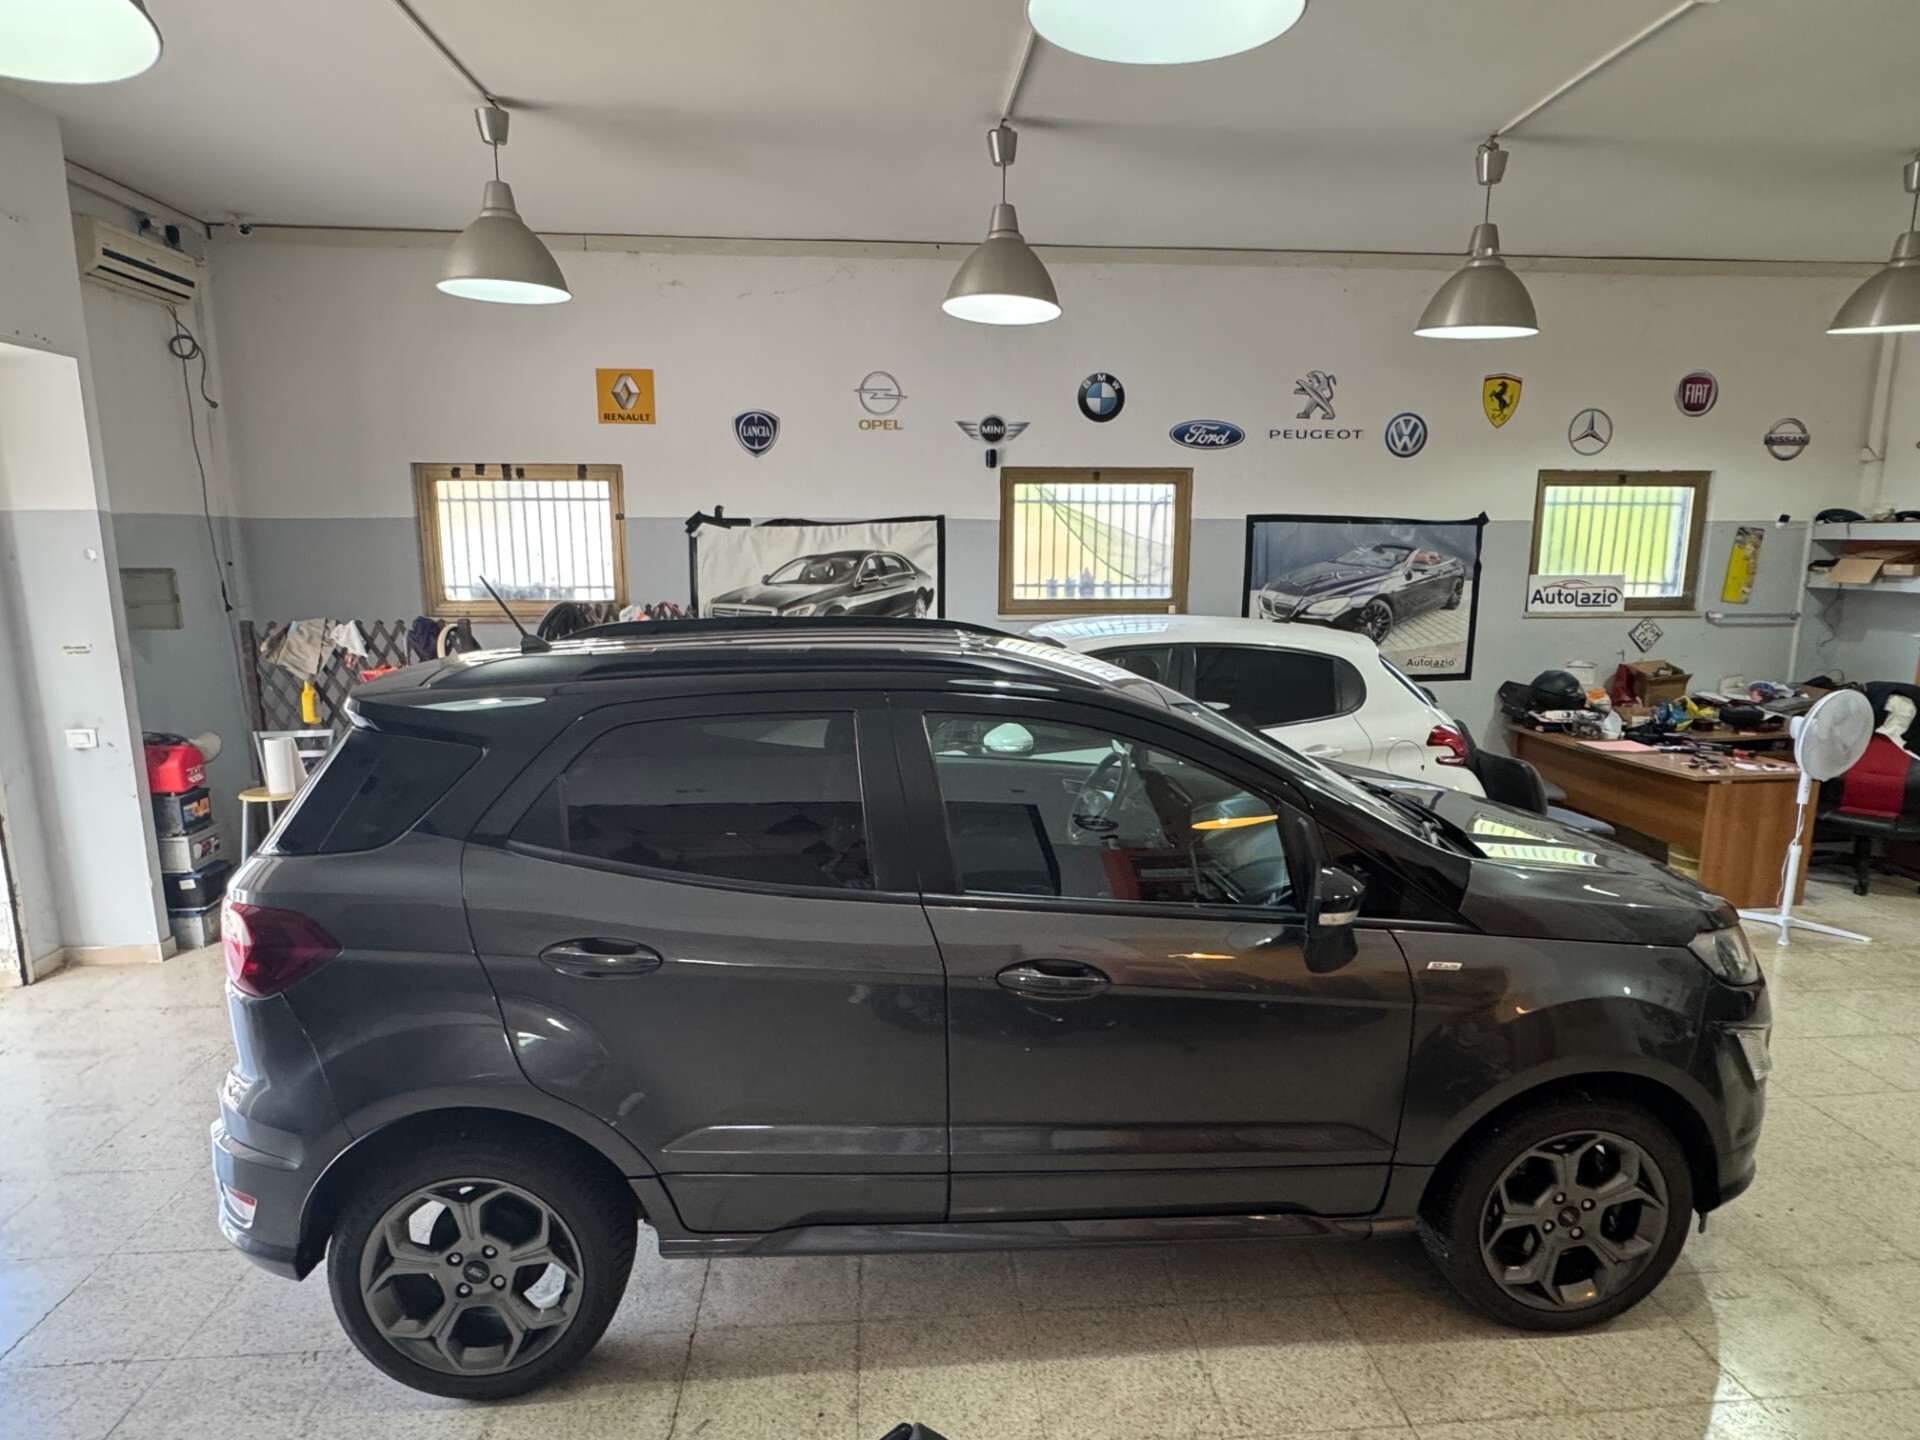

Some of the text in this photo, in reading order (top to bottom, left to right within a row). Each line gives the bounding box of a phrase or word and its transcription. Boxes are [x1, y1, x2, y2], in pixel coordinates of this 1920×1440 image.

[1082, 373, 1121, 390] BMW
[1684, 383, 1710, 404] FIAT
[603, 412, 651, 422] RENAULT
[742, 425, 771, 437] LANCIA
[858, 419, 904, 431] OPEL
[981, 425, 1005, 435] MINI
[1184, 423, 1231, 445] Ford
[1268, 429, 1364, 440] PEUGEOT
[1767, 435, 1806, 444] NISSAN
